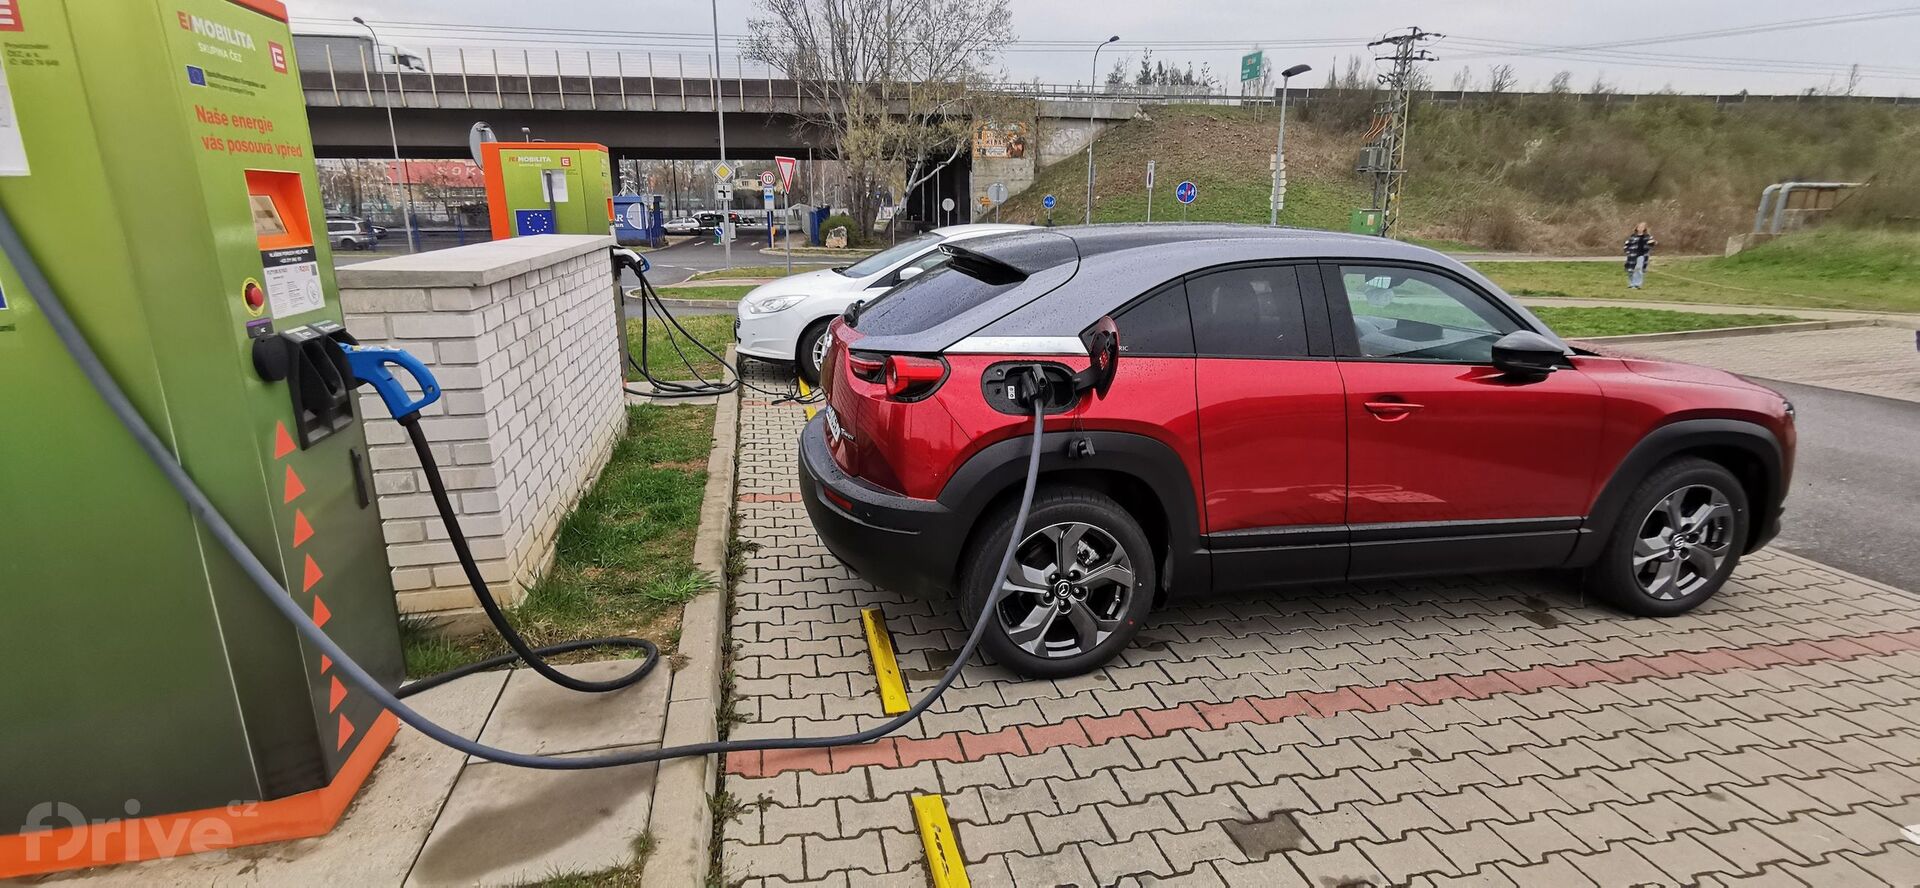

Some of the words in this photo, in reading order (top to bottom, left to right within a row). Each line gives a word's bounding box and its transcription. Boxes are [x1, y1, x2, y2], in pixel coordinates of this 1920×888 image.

[194, 104, 229, 126] Naše
[231, 114, 273, 134] energie
[201, 134, 225, 151] vás
[227, 138, 273, 155] posouvá
[275, 142, 303, 159] vpřed
